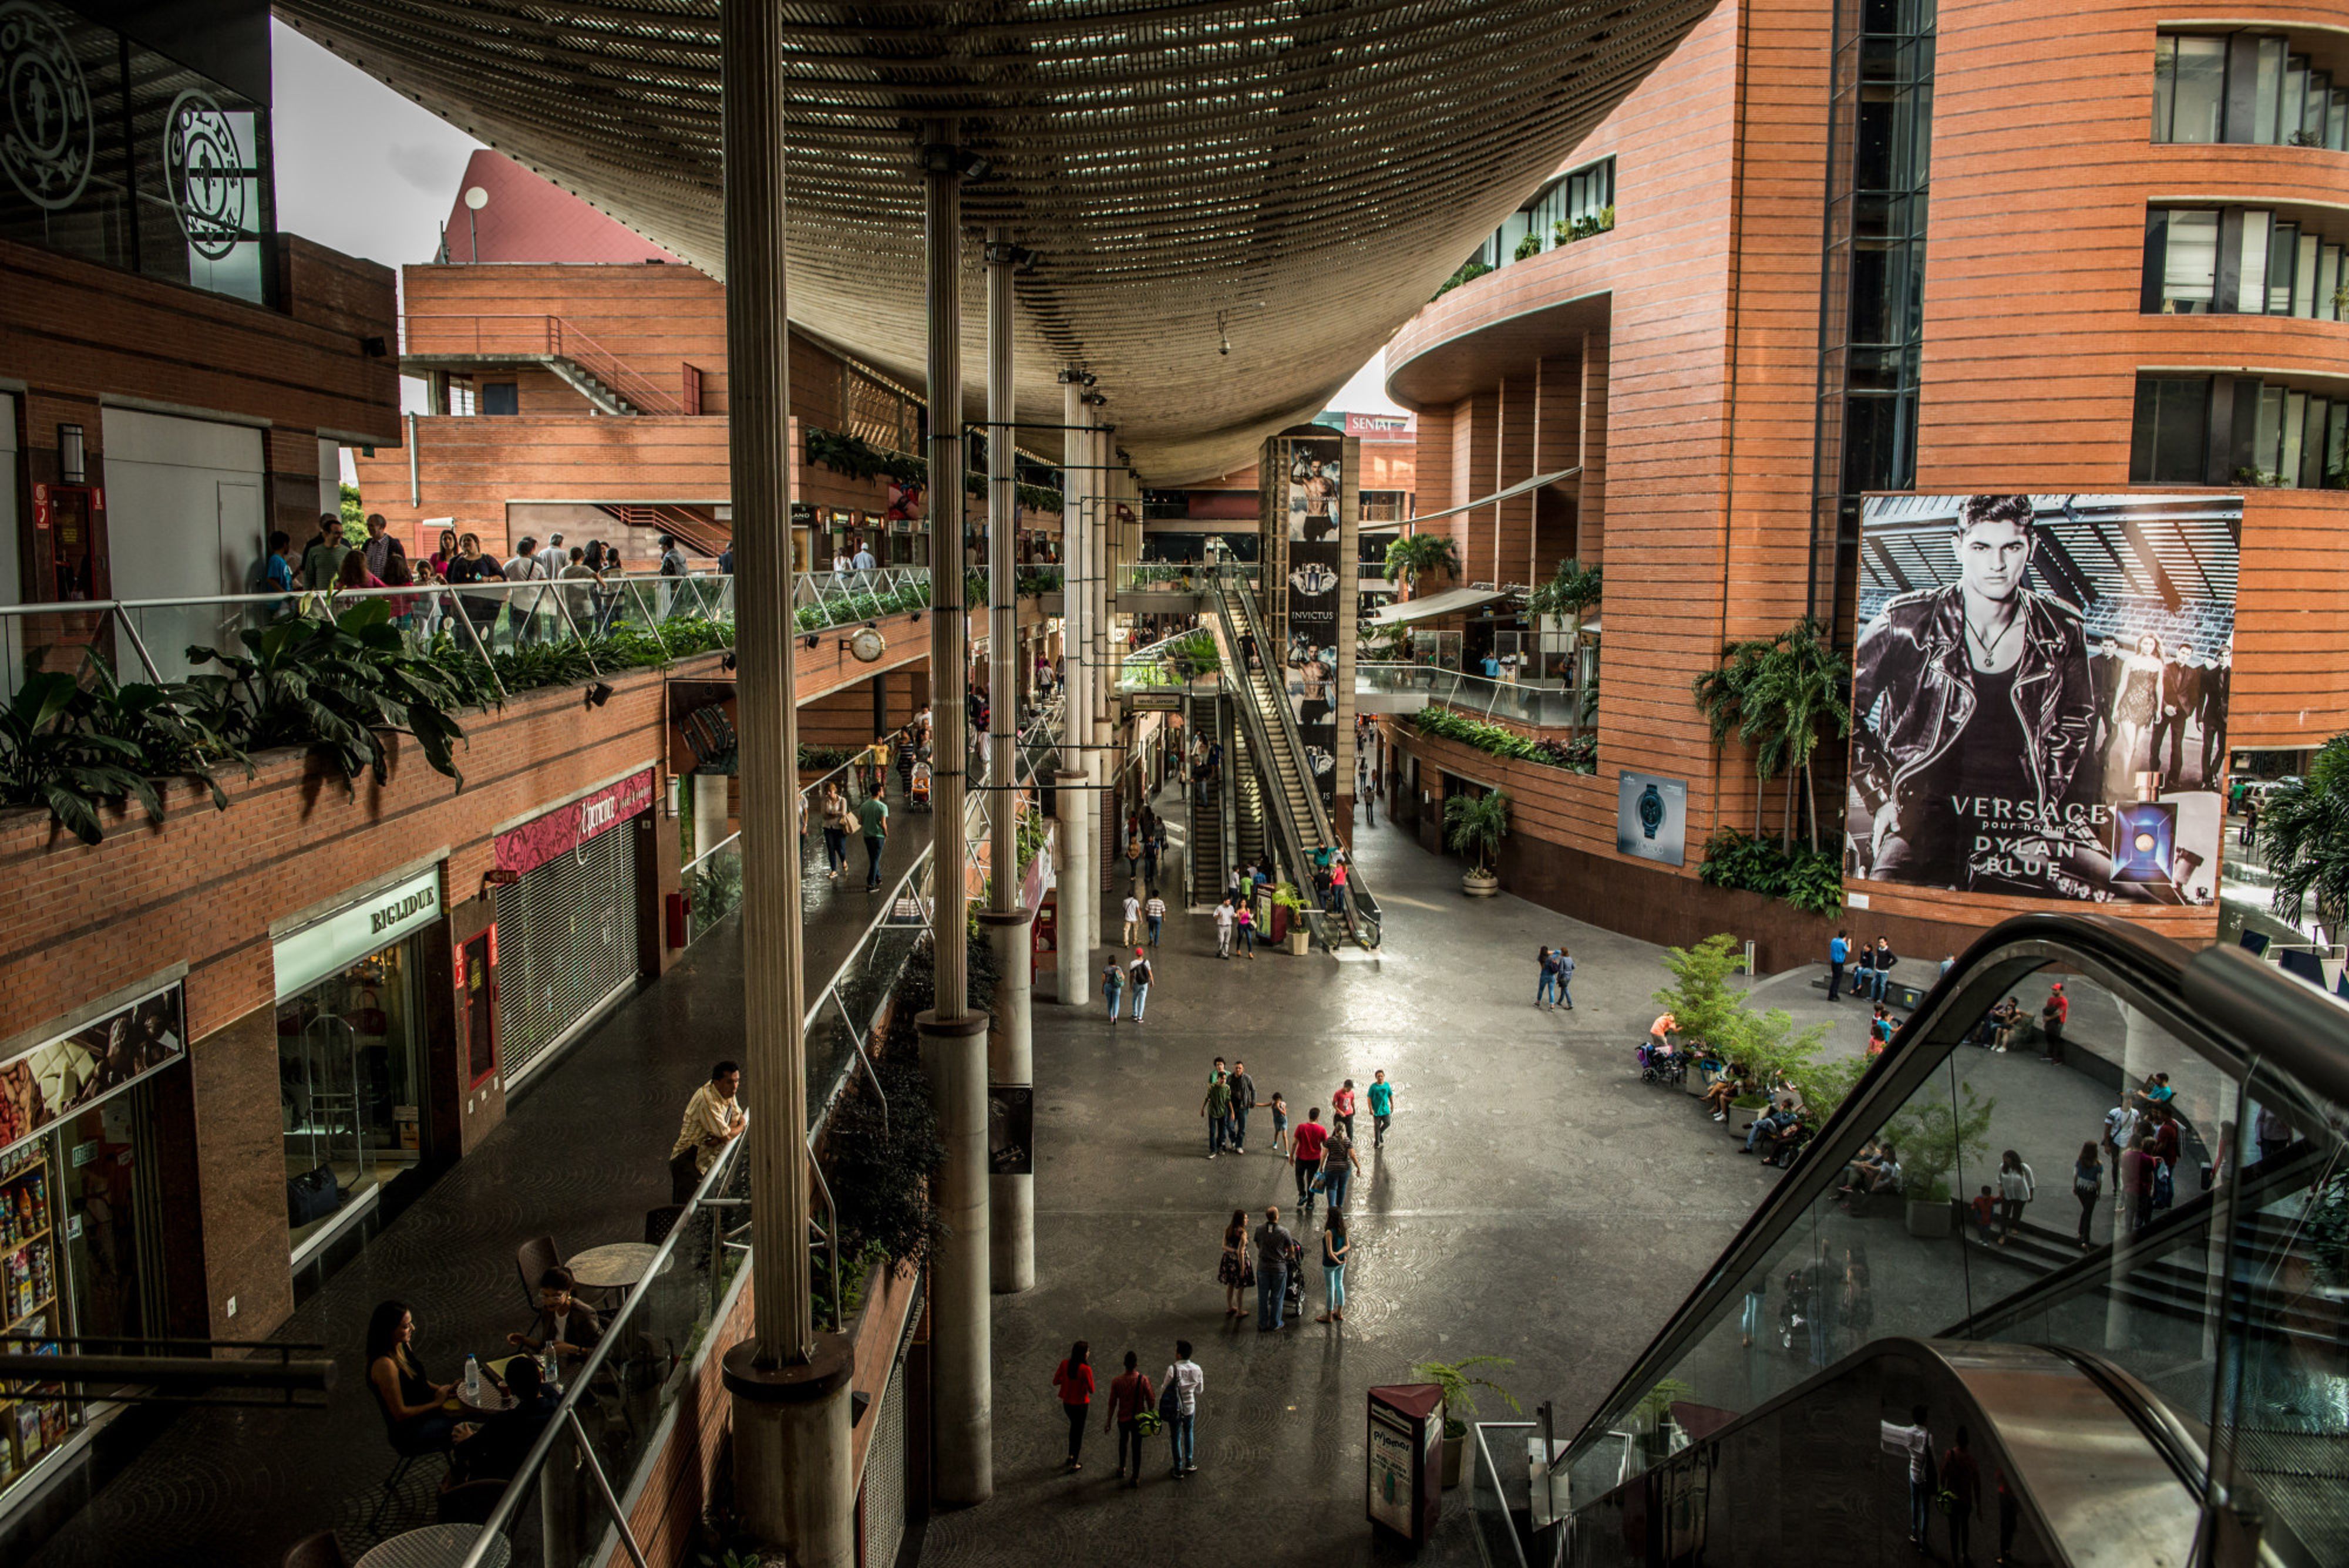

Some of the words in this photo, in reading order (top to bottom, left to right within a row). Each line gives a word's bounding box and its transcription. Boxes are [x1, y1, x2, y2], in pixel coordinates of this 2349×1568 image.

[0, 18, 84, 122] OLD'S
[171, 103, 238, 189] GOLD'S
[1352, 416, 1391, 431] SENIAT
[1292, 611, 1334, 620] INVICTUS
[1951, 795, 2107, 824] VERSACE
[1982, 820, 2015, 830] pour
[2024, 822, 2075, 834] homme
[1974, 836, 2075, 858] DYLAN
[1987, 856, 2060, 880] BLUE
[370, 886, 434, 934] BIGLIDUE
